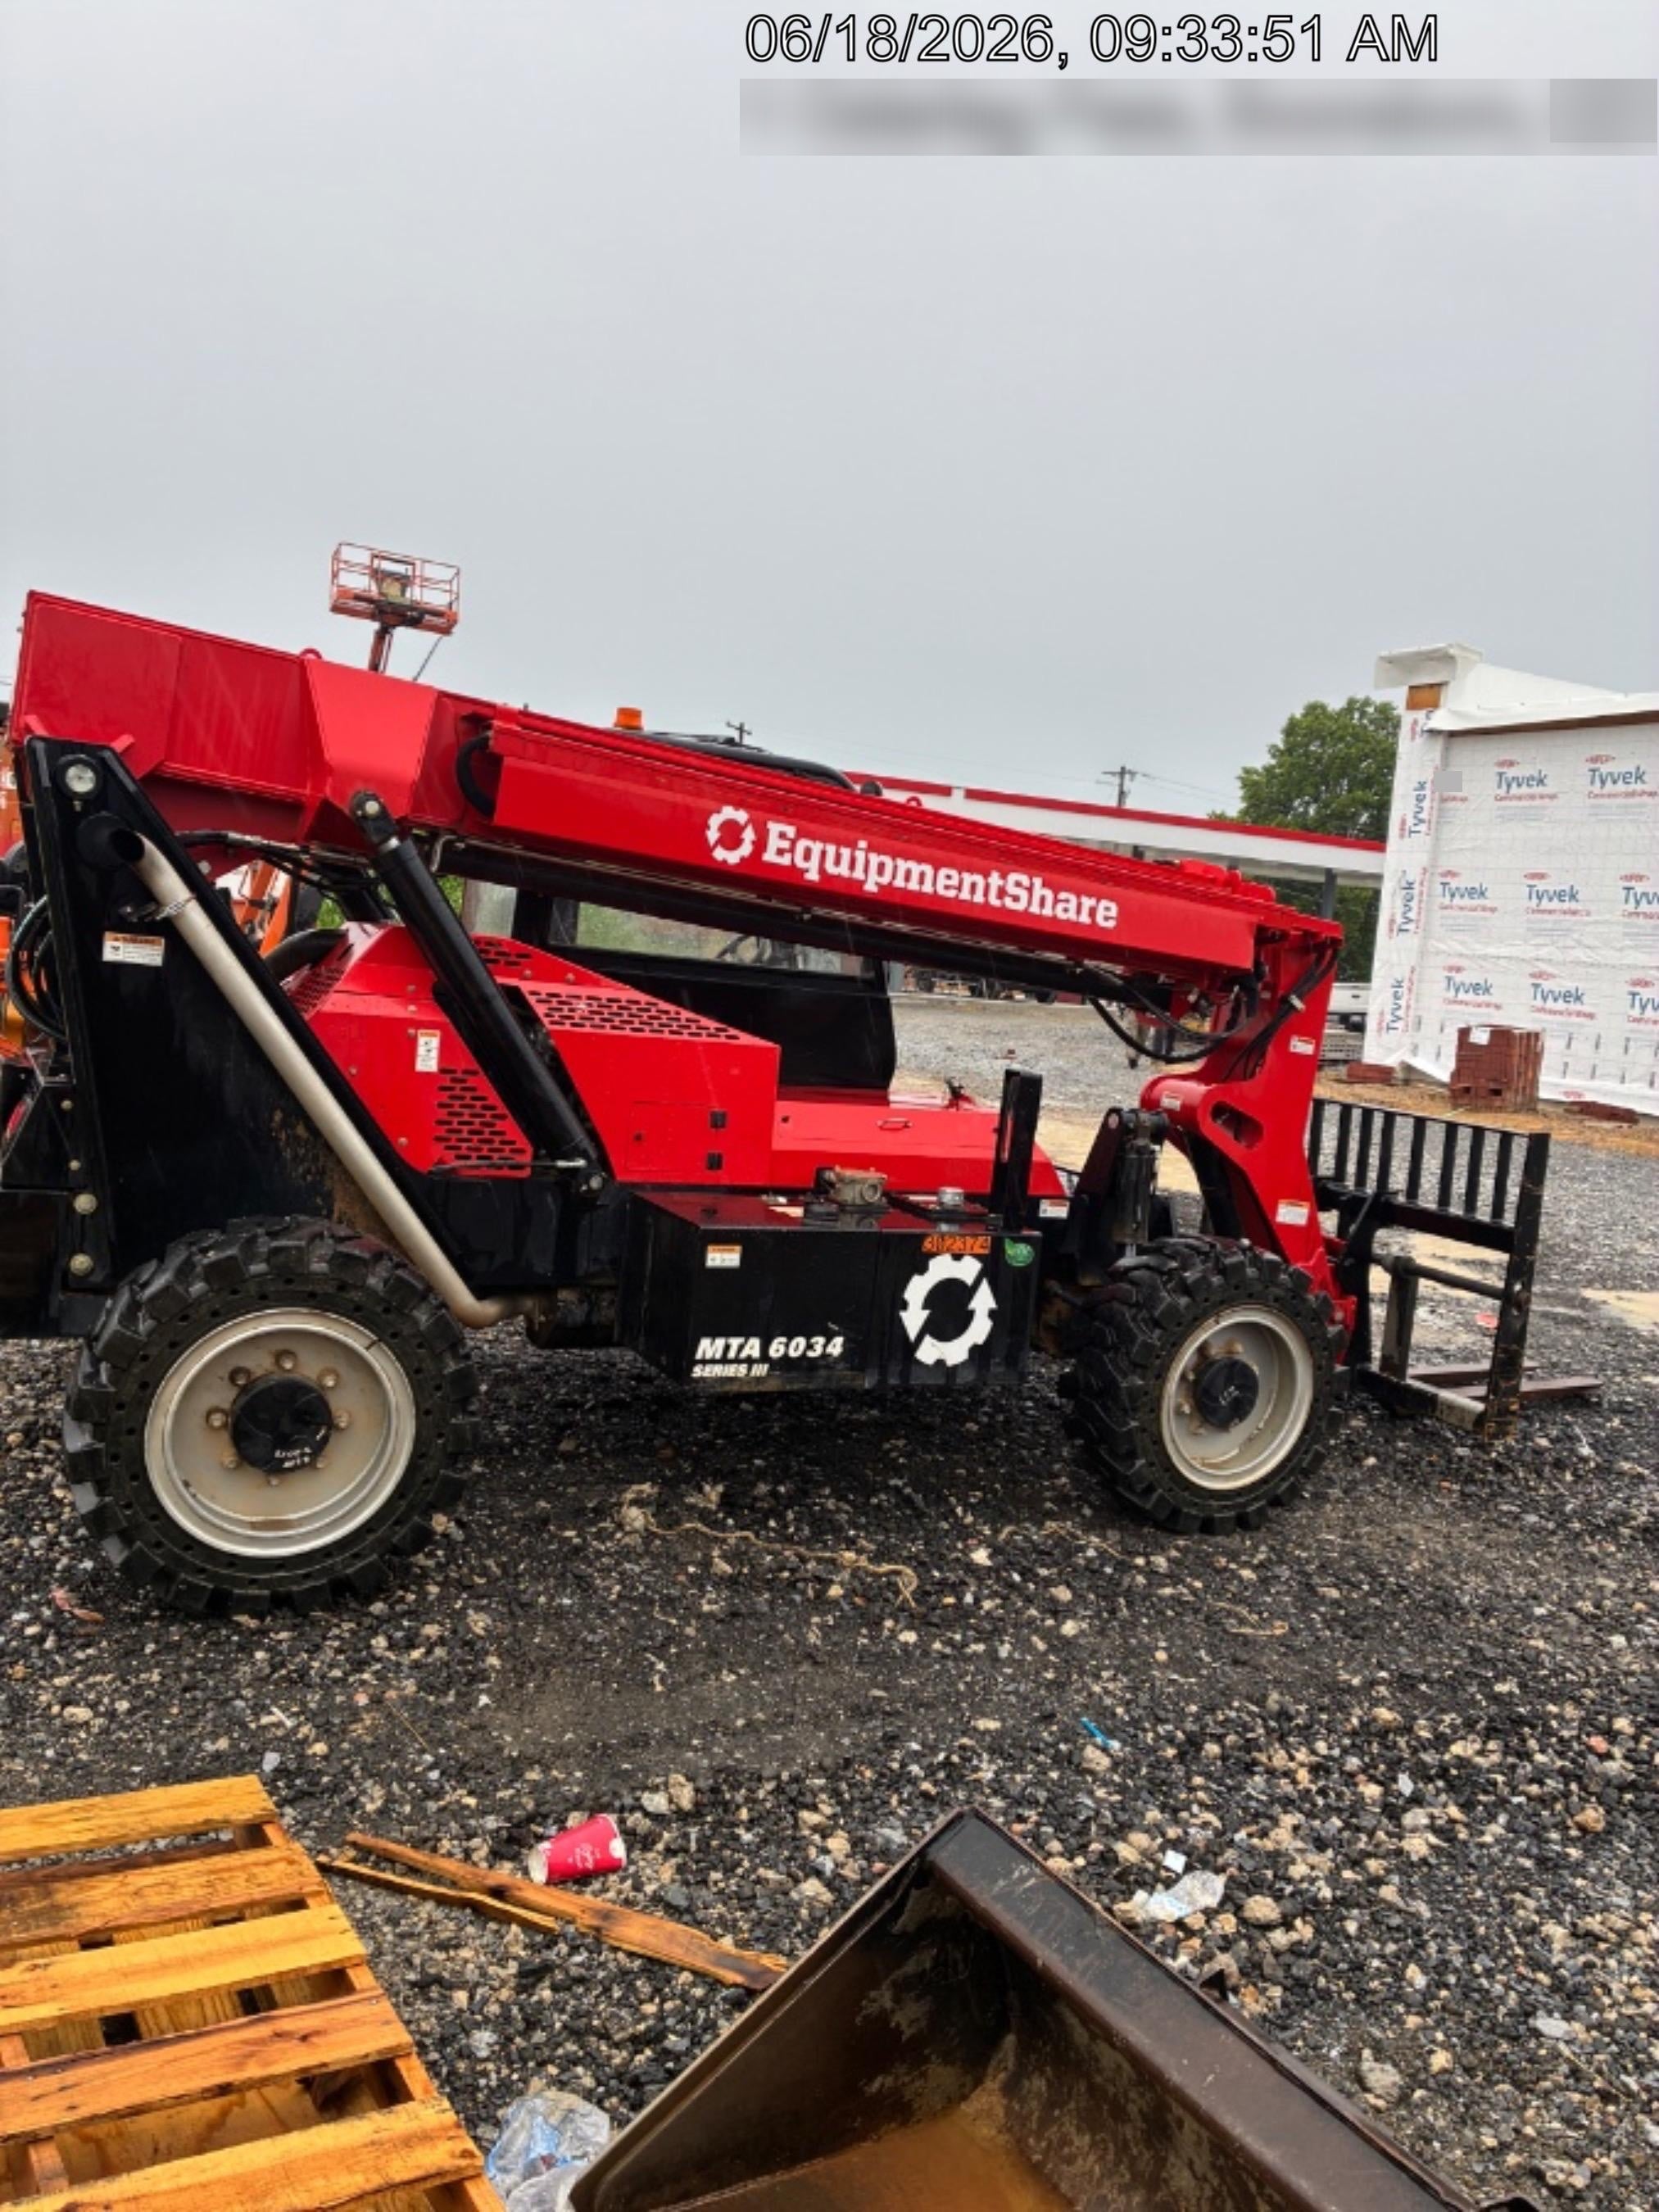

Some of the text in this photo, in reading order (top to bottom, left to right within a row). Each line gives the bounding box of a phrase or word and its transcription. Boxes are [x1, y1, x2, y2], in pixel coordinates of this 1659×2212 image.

[1496, 770, 1548, 794] Tyvek
[1586, 766, 1647, 789] Tyvek
[1408, 781, 1427, 838] Tyvek
[761, 820, 1118, 929] EquipmentShare
[1440, 882, 1488, 901] Tyvek
[1526, 885, 1580, 907] Tyvek
[1397, 878, 1416, 936] Tyvek
[1444, 976, 1494, 997] Tyvek
[1530, 982, 1585, 1004] Tyvek
[1386, 977, 1404, 1033] Tyvek
[695, 1336, 845, 1360] MTA 6034
[691, 1363, 748, 1377] SERIES
